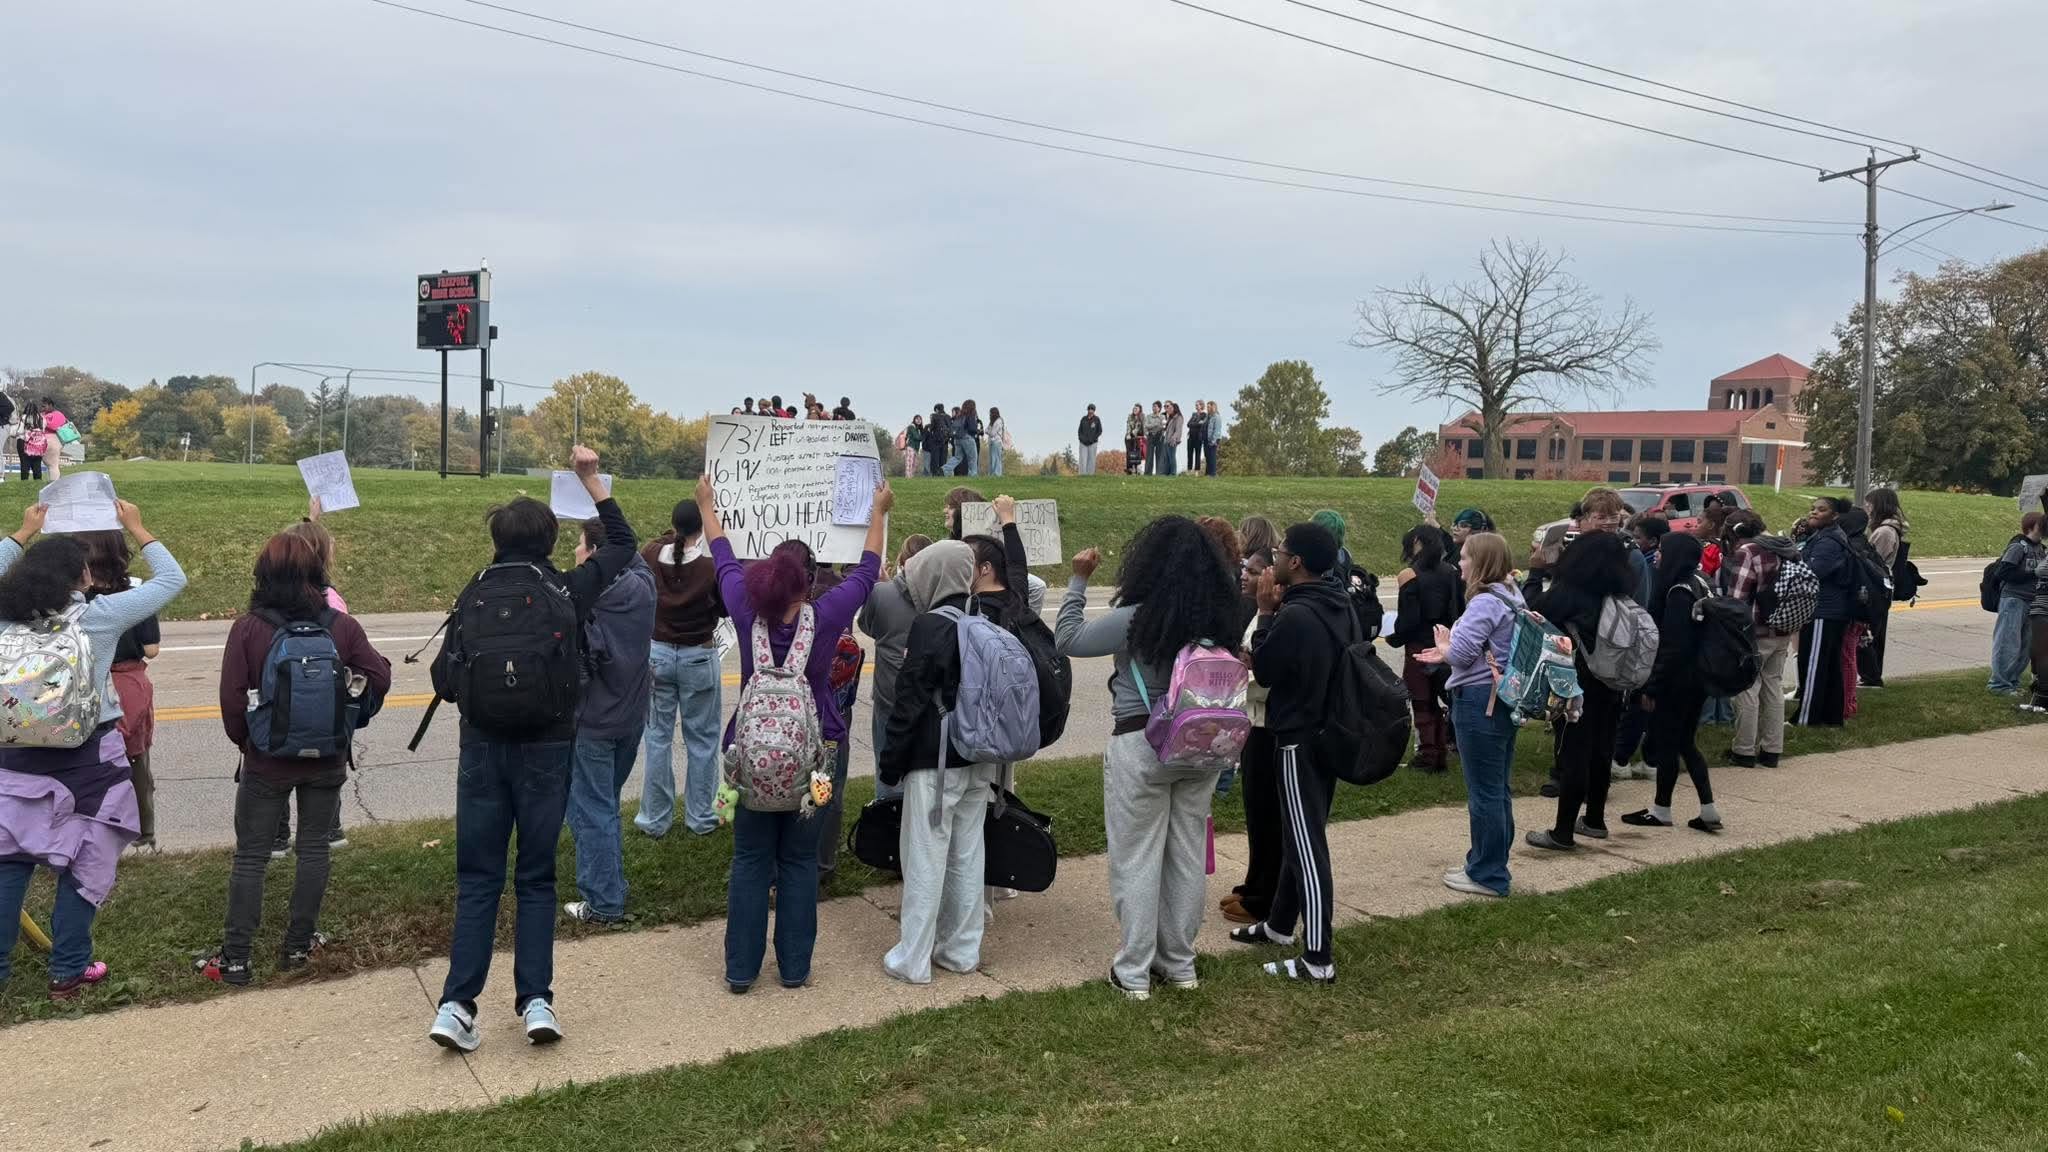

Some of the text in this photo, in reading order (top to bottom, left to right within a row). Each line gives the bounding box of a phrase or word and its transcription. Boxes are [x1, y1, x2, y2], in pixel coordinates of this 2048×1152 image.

[449, 287, 476, 298] SCHOOL
[771, 419, 804, 433] Reported
[715, 421, 766, 455] 73%
[770, 431, 794, 446] LEFT
[749, 483, 780, 494] Reported
[714, 500, 833, 531] AN YOU HEAR
